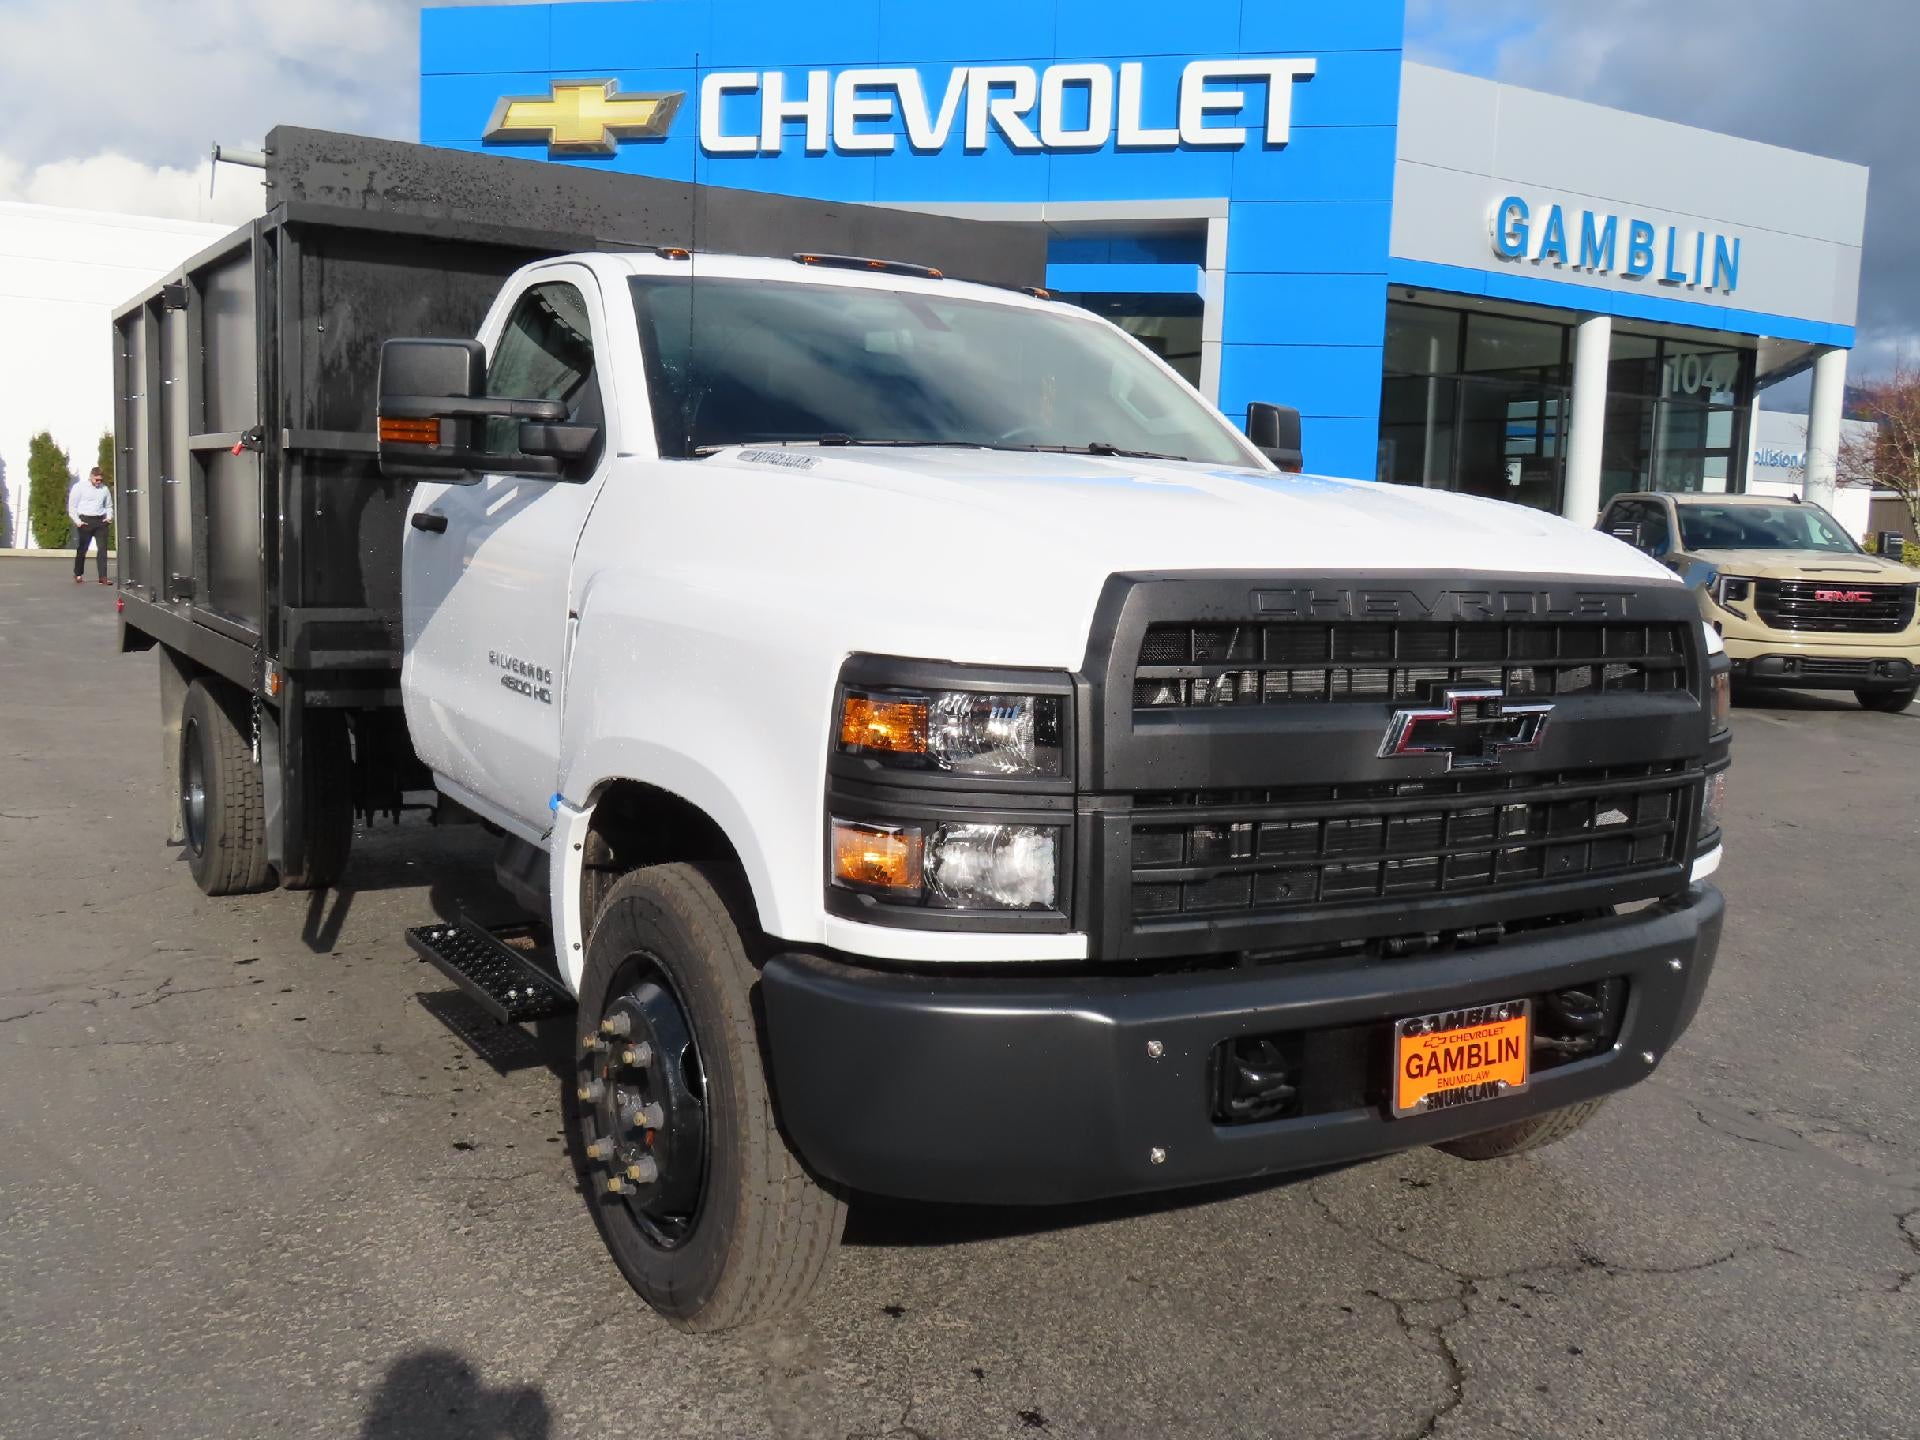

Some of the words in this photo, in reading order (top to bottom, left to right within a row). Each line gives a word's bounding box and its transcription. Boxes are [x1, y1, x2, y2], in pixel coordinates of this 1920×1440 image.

[700, 58, 1316, 154] CHEVROLET
[1493, 195, 1741, 294] GAMBLIN
[1753, 447, 1798, 468] ollision
[1253, 590, 1638, 616] CHEVROLET
[1814, 590, 1873, 602] GMC
[488, 650, 552, 685] SILVERADO
[1449, 1026, 1506, 1044] CHEVROLET
[1405, 1035, 1520, 1080] GAMBLIN
[1437, 1069, 1491, 1089] ENUMCLAW
[1426, 1080, 1500, 1111] ENUMCLAW
